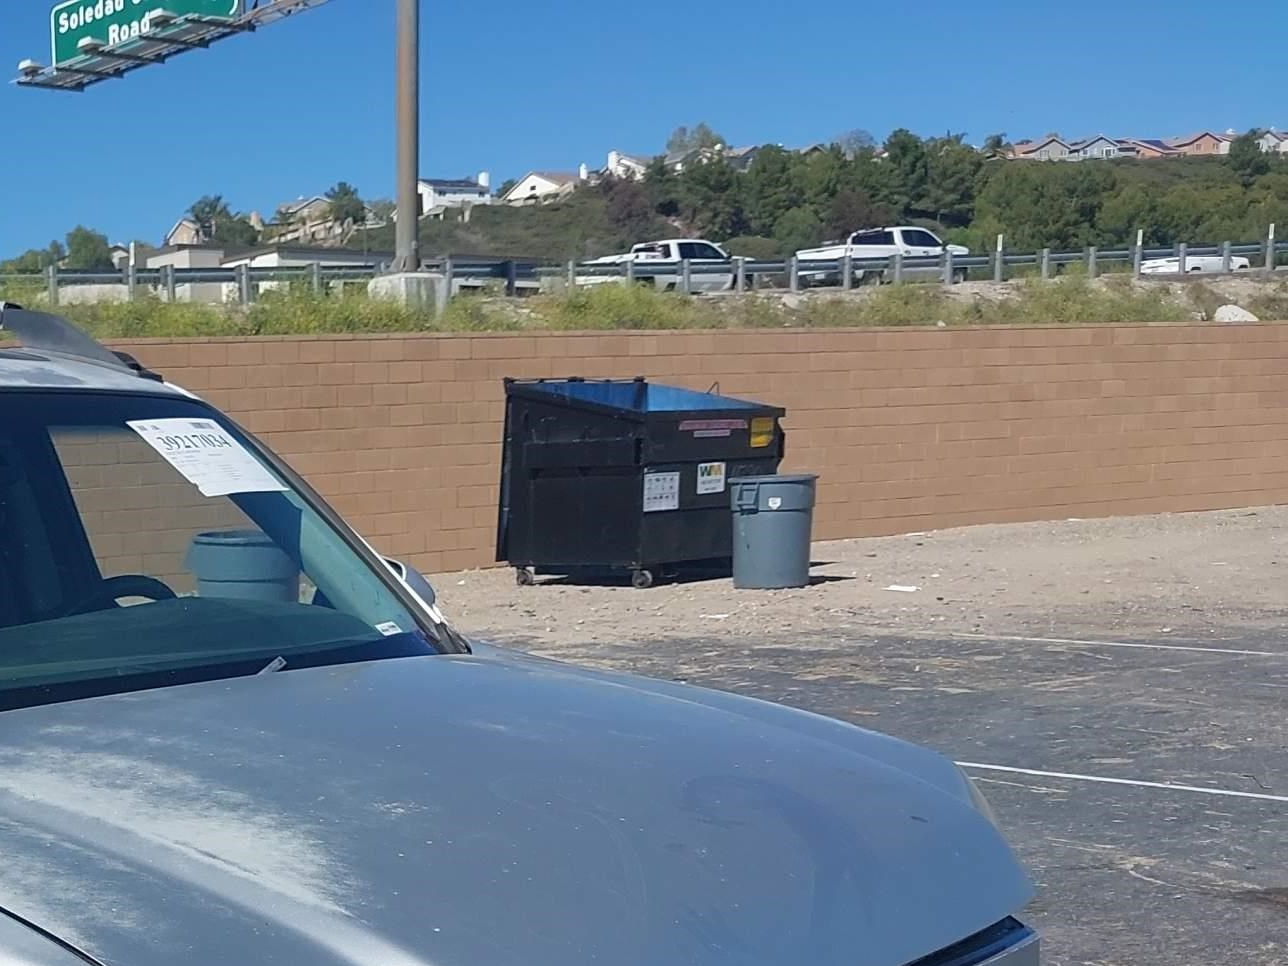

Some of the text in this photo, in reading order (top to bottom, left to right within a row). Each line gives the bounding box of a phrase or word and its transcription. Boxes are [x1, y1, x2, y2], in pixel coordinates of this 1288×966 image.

[58, 0, 124, 34] Soledad
[108, 11, 150, 46] Road
[156, 434, 232, 451] 39217034
